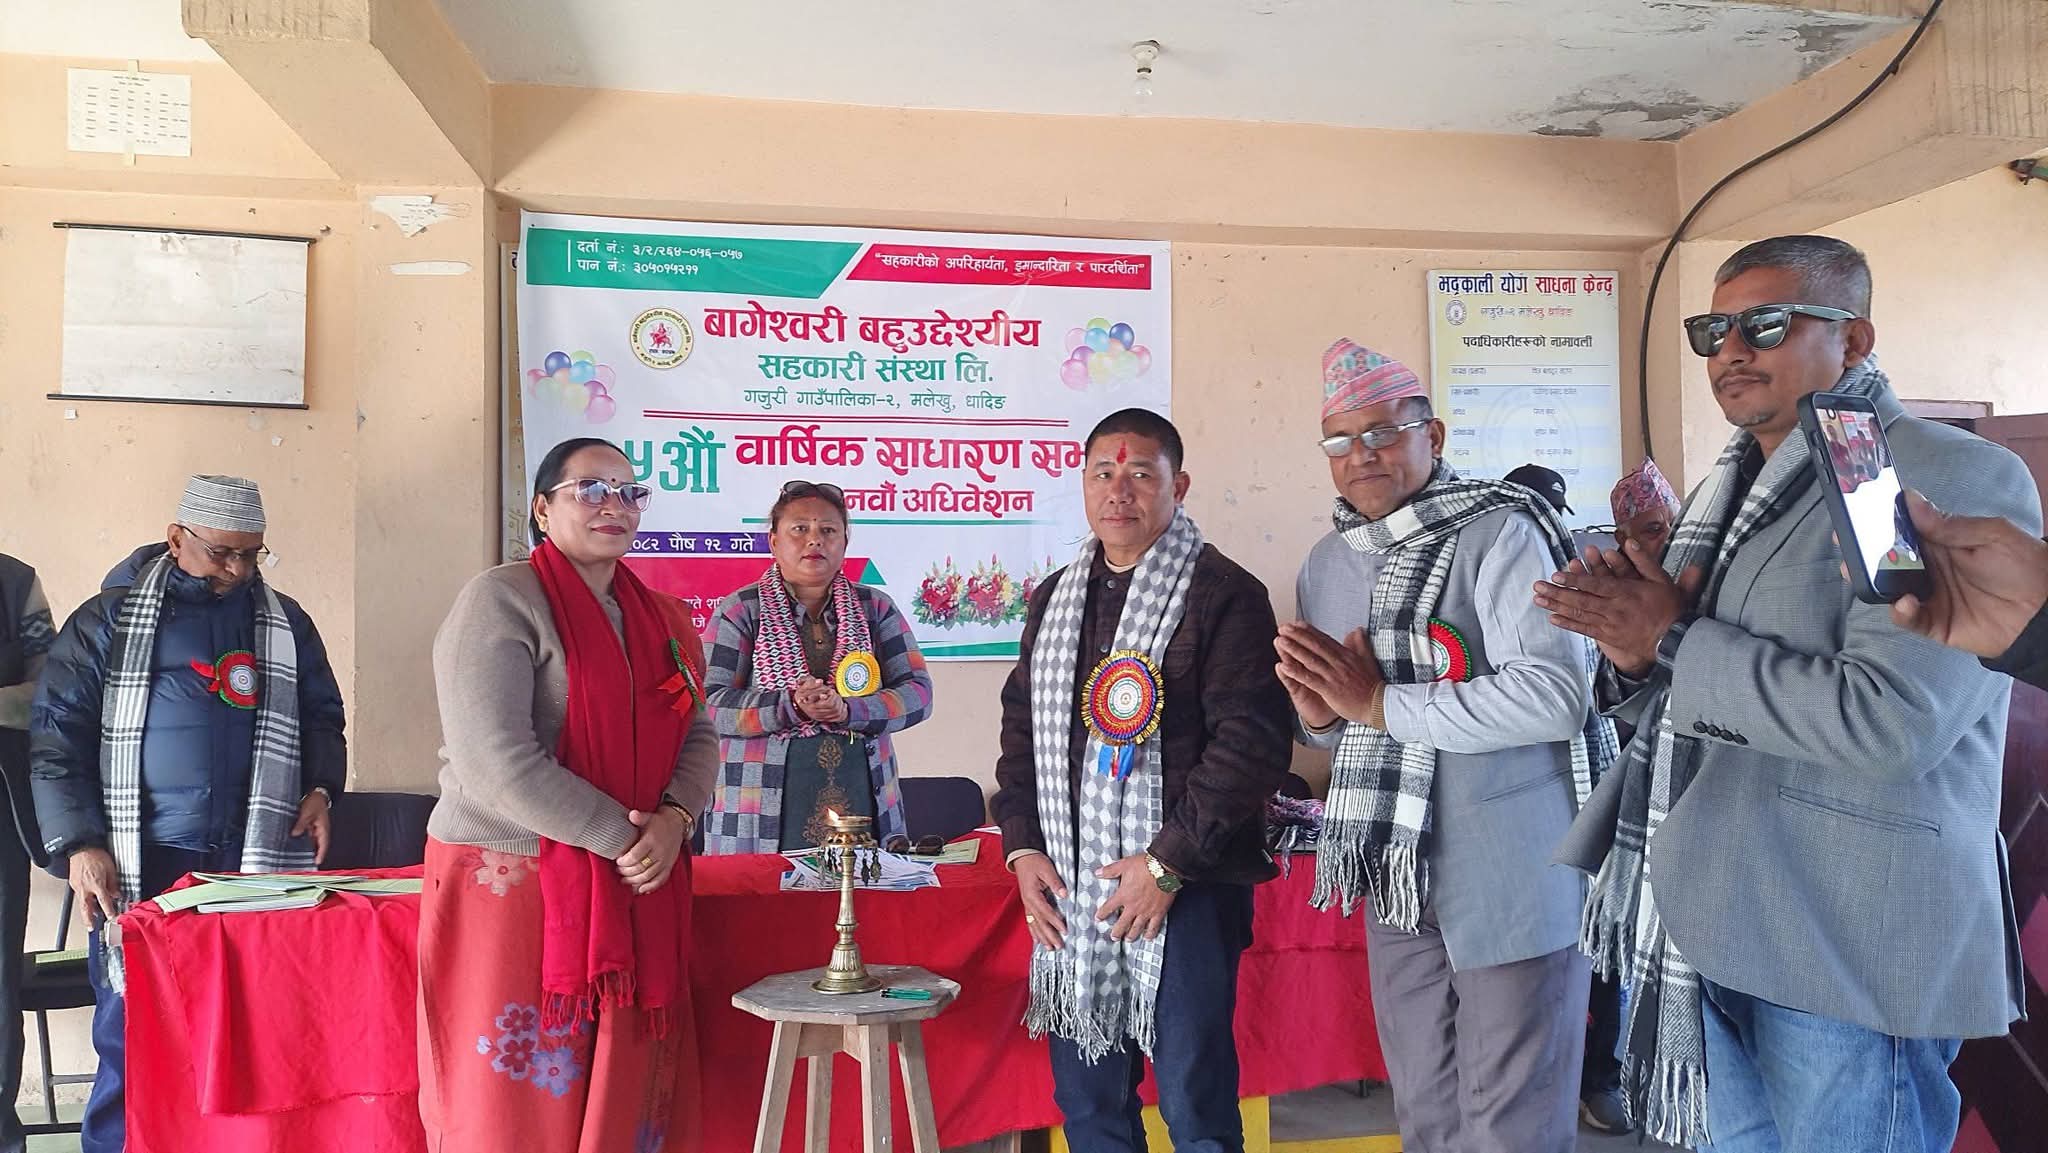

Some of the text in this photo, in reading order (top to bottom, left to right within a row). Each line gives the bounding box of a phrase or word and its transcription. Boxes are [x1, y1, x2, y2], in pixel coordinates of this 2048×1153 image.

[577, 239, 599, 253] दर्ता
[577, 259, 600, 271] पान
[1075, 262, 1083, 272] र
[1500, 272, 1528, 293] योग
[1534, 276, 1577, 294] साधना
[1582, 273, 1613, 296] केन्द्र
[704, 300, 847, 343] बागेश्वरी
[859, 309, 1042, 353] बहुउद्देश्यीय
[1550, 335, 1592, 347] नामावली
[758, 351, 993, 383] सहकारी संस्था लि.
[744, 386, 788, 410] गजुरी
[966, 391, 1007, 410] धादिङ
[624, 425, 726, 493] ५औं
[735, 424, 868, 466] वार्षिक
[875, 437, 1023, 483] साधारण
[903, 482, 1035, 518] अधिवेशन
[629, 532, 755, 551] ०८२ पौष १२ गते
